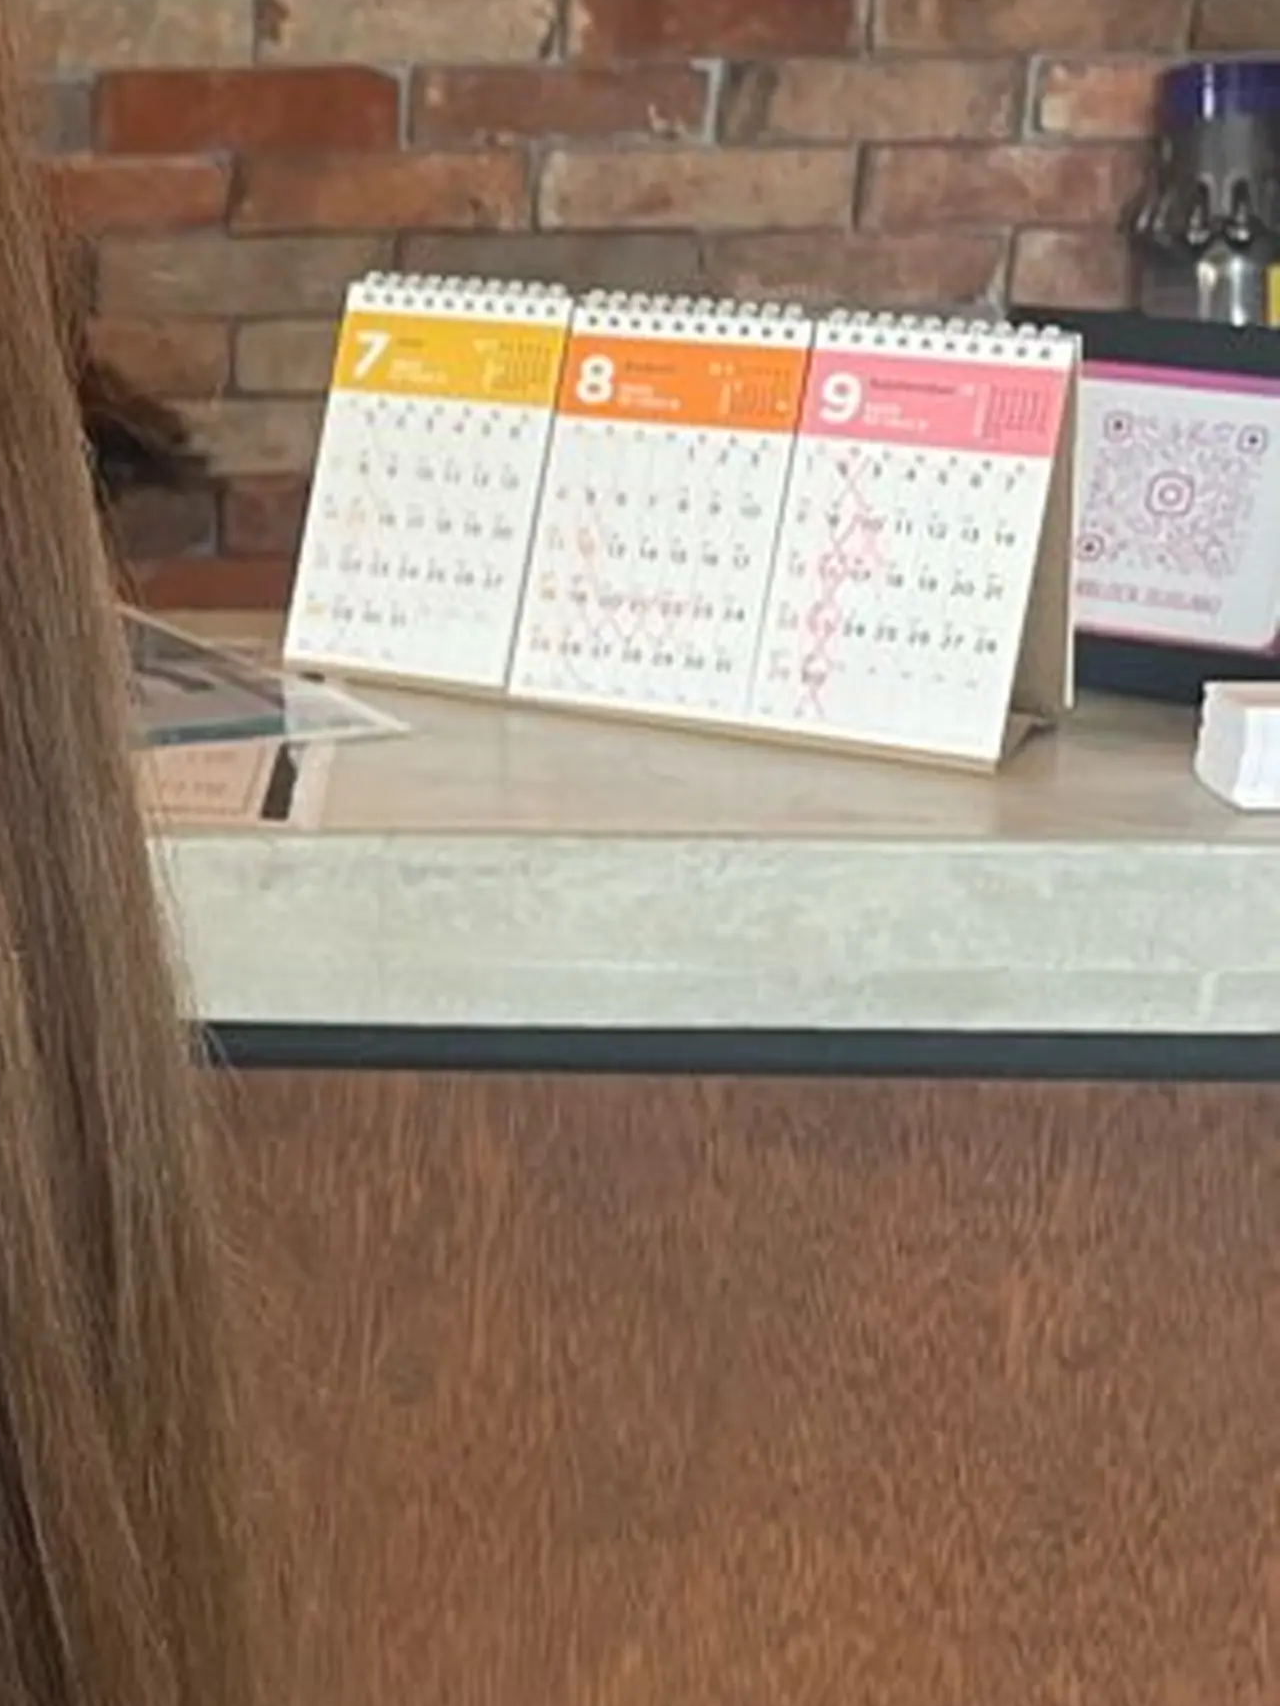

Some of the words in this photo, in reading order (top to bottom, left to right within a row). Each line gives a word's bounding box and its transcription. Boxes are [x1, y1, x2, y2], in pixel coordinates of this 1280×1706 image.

[354, 330, 391, 380] 7
[576, 354, 614, 404] 8
[819, 371, 862, 423] 9
